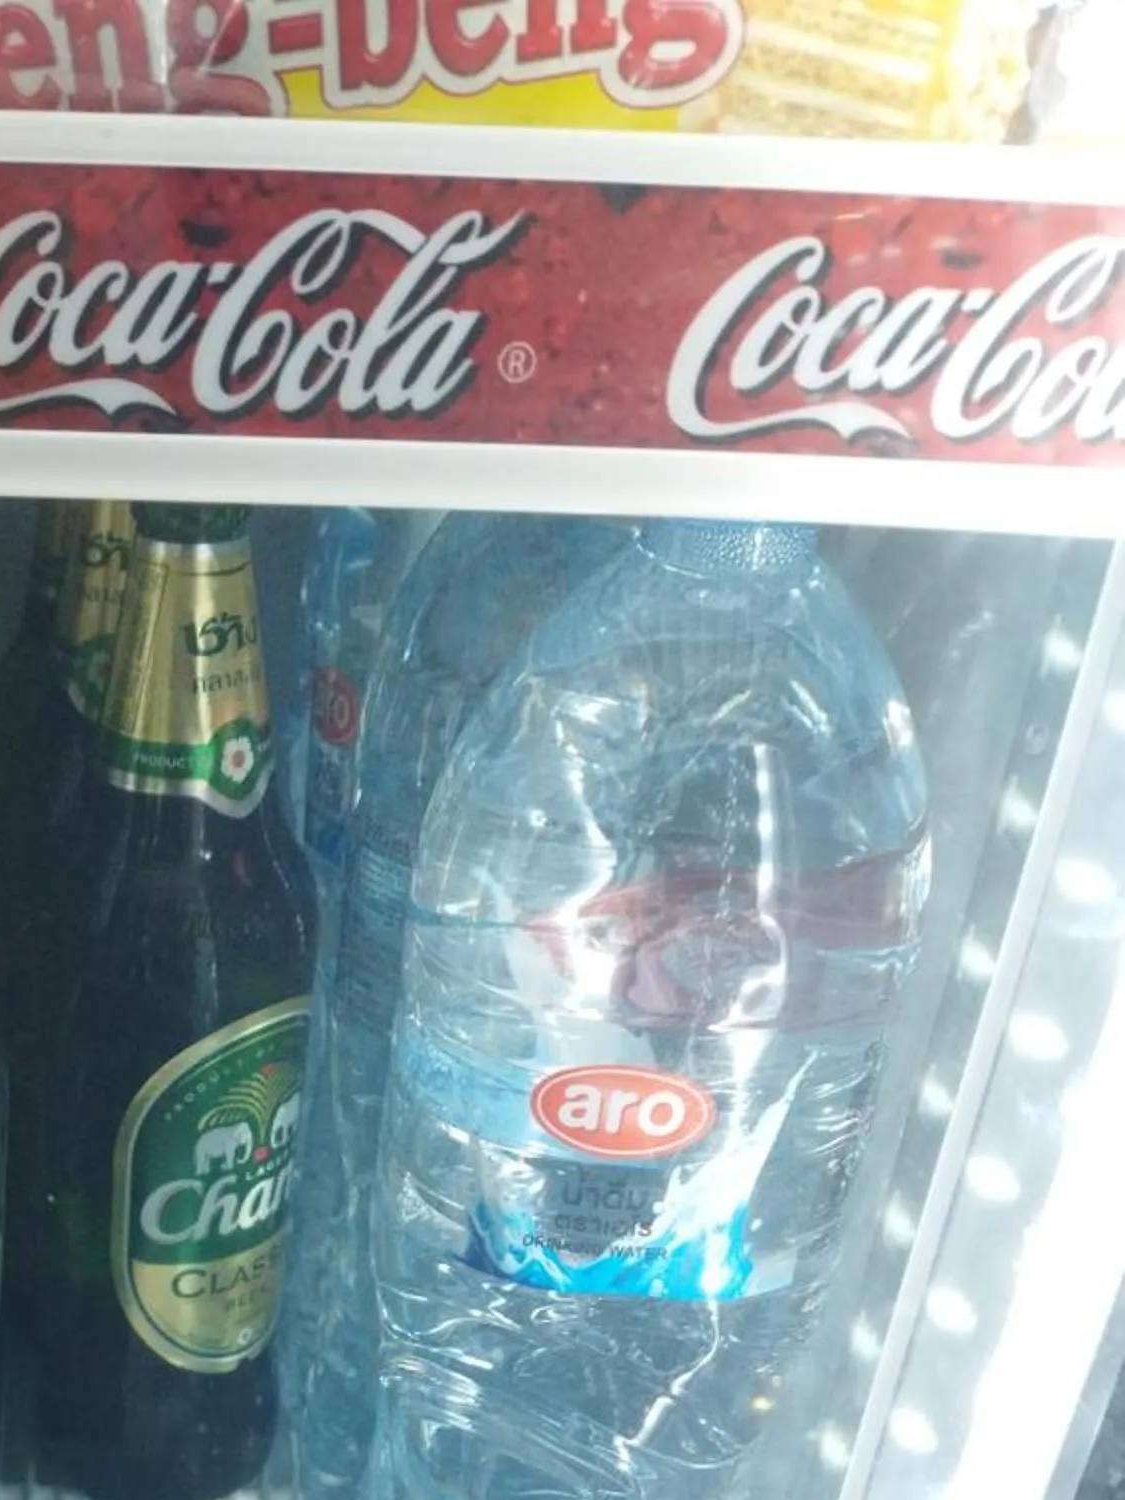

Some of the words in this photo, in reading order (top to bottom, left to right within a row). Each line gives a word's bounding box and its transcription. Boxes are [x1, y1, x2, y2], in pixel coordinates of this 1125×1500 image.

[665, 235, 1125, 440] Coca-Co
[557, 1083, 685, 1137] aro
[139, 1163, 295, 1246] Chan
